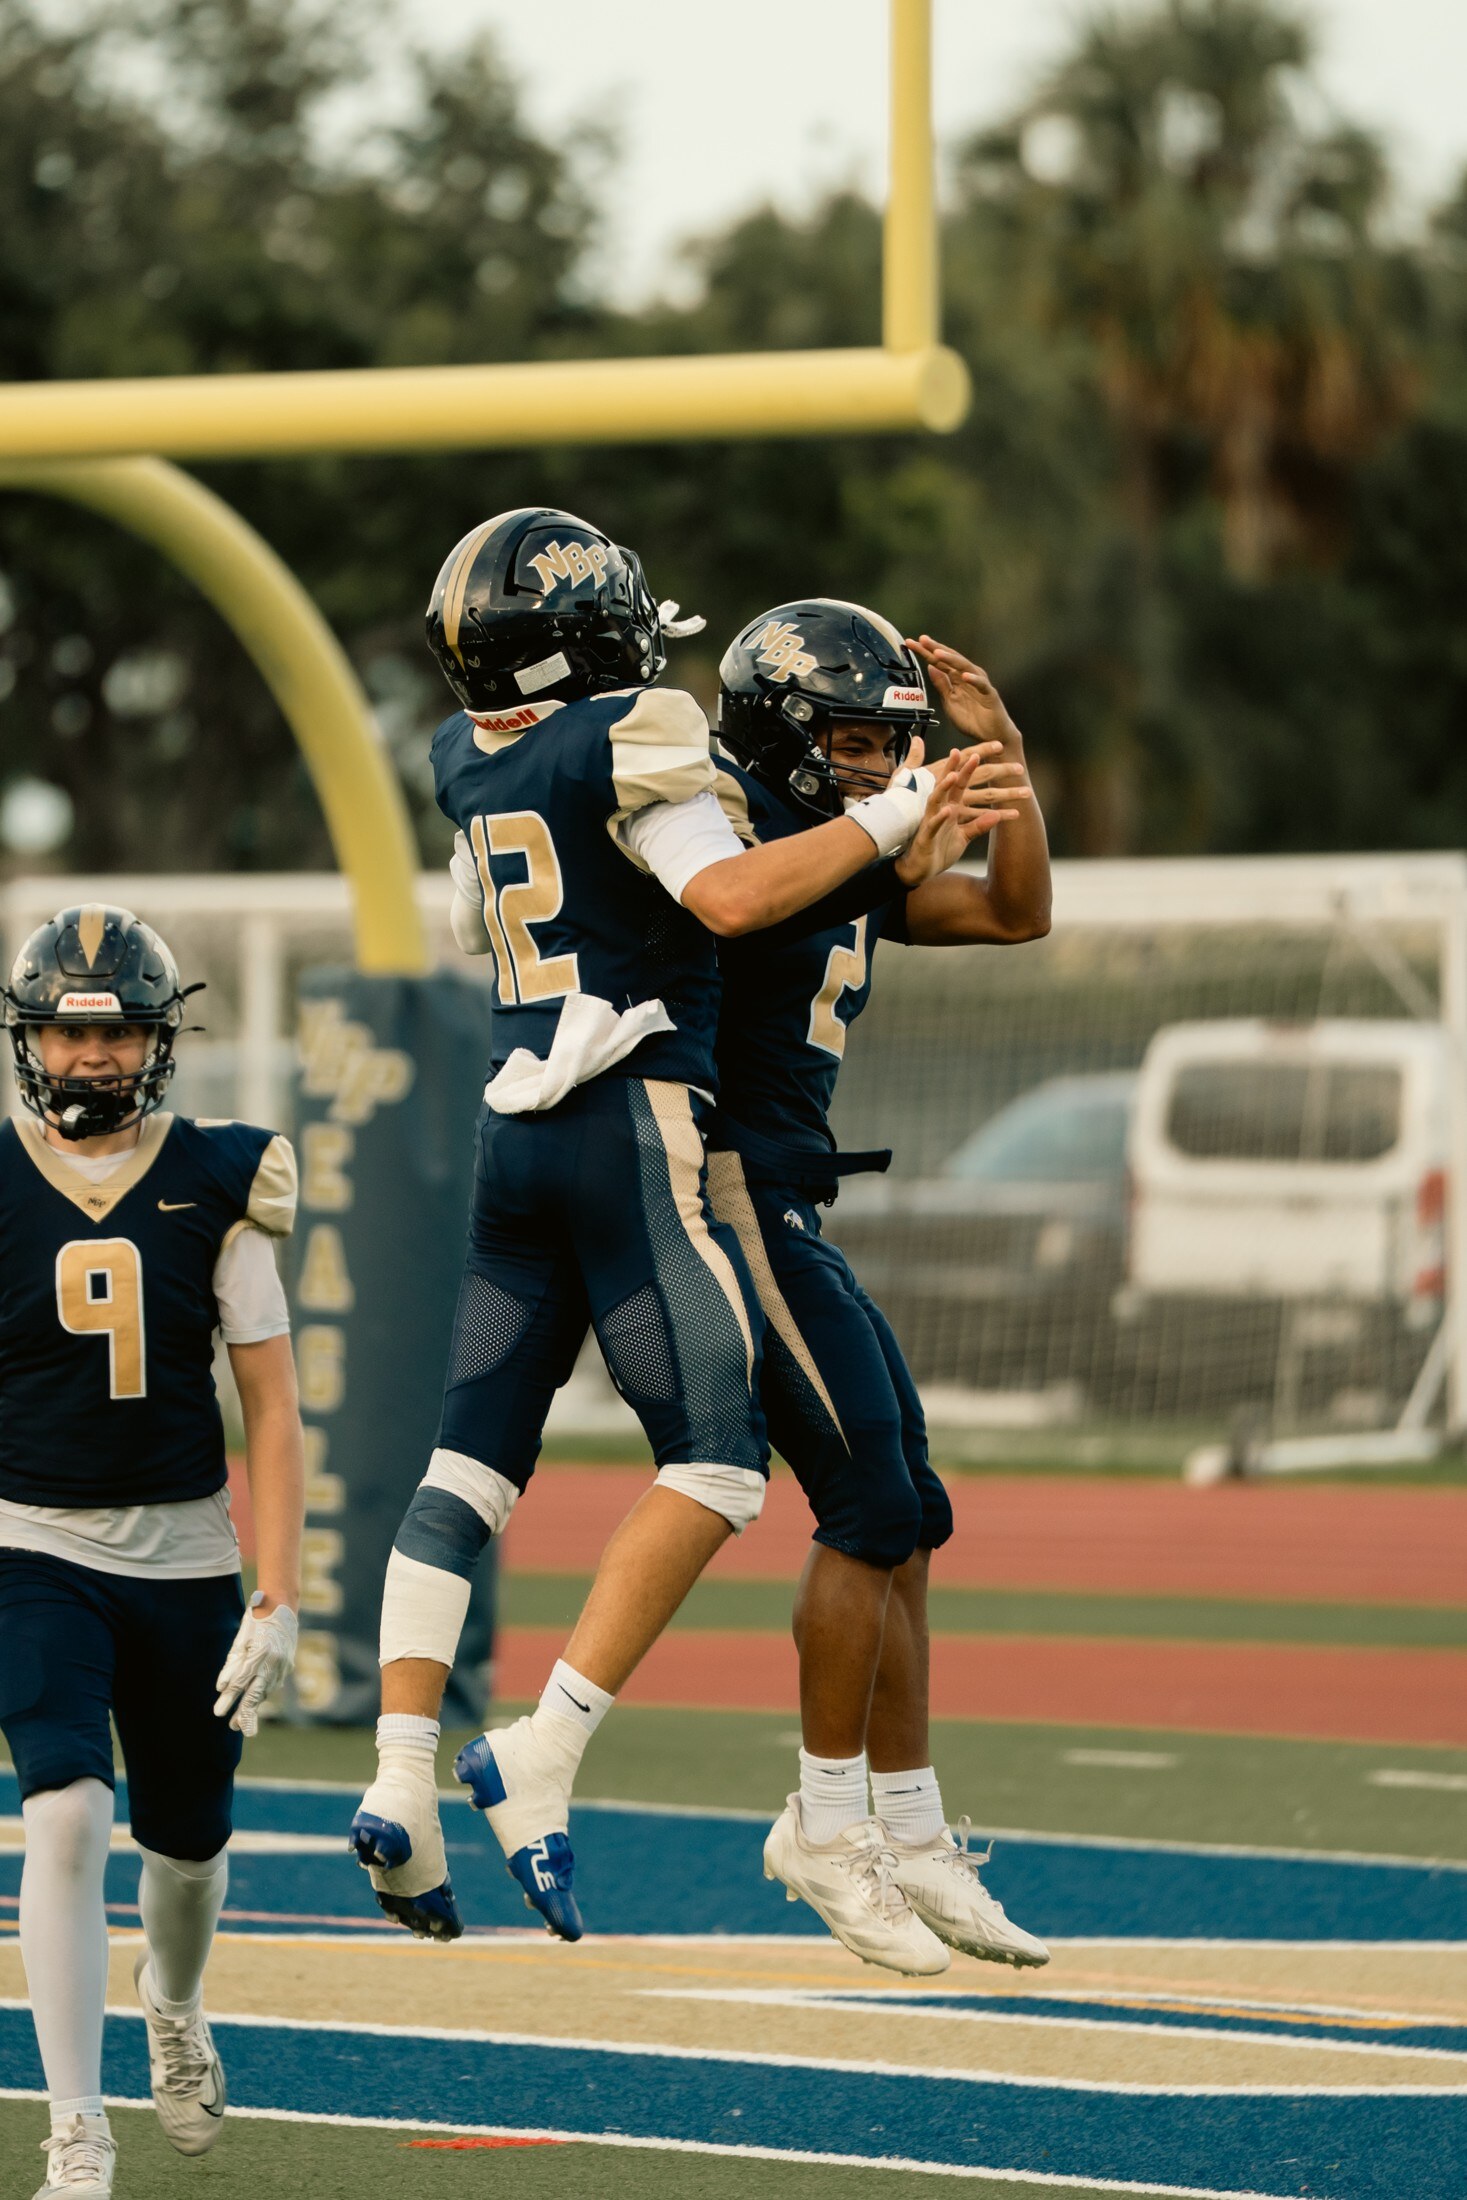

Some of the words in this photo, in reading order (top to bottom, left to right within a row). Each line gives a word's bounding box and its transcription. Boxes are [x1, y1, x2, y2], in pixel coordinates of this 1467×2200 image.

[527, 540, 609, 597] NBP
[744, 621, 819, 683] NBP
[470, 810, 581, 1005] 12
[66, 996, 113, 1007] Riddell
[55, 1237, 147, 1400] 9
